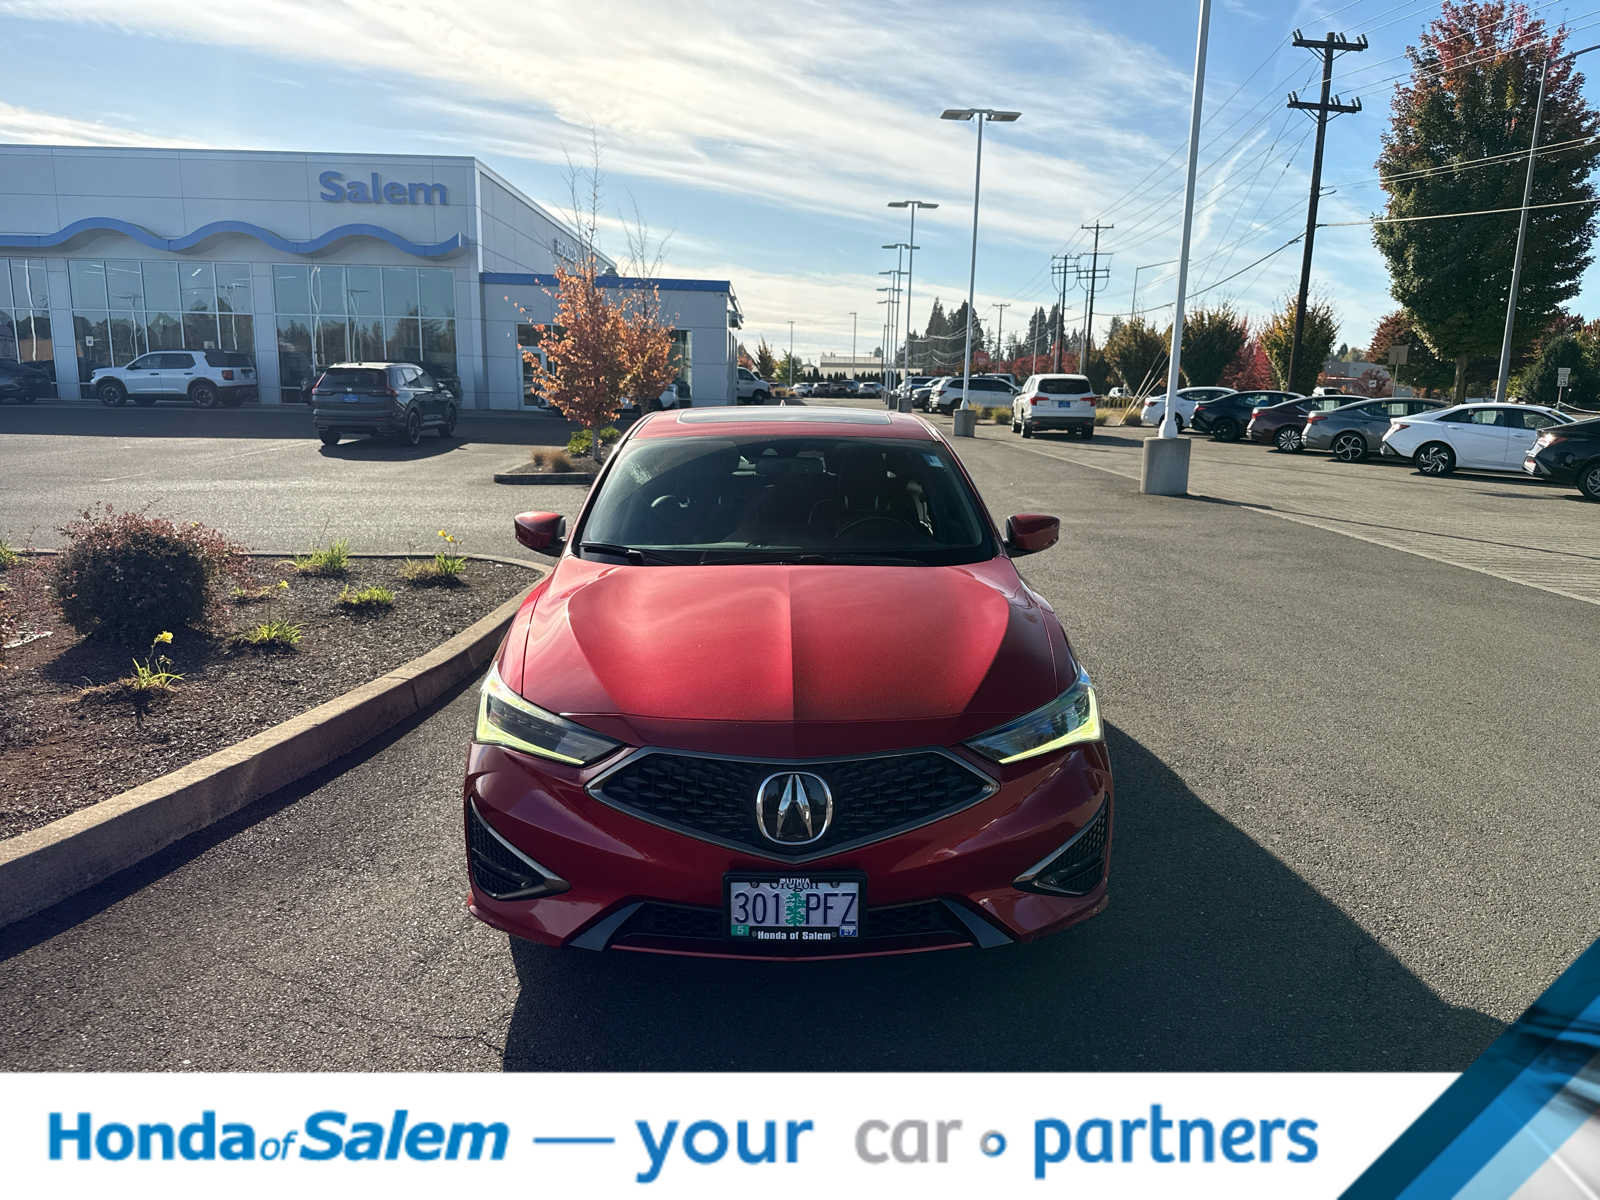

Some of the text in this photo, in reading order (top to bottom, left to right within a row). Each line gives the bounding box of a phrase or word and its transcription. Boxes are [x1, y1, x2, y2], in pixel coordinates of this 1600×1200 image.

[319, 170, 449, 205] Salem
[734, 892, 857, 924] 301 PFZ
[757, 931, 831, 940] Honda of Salem
